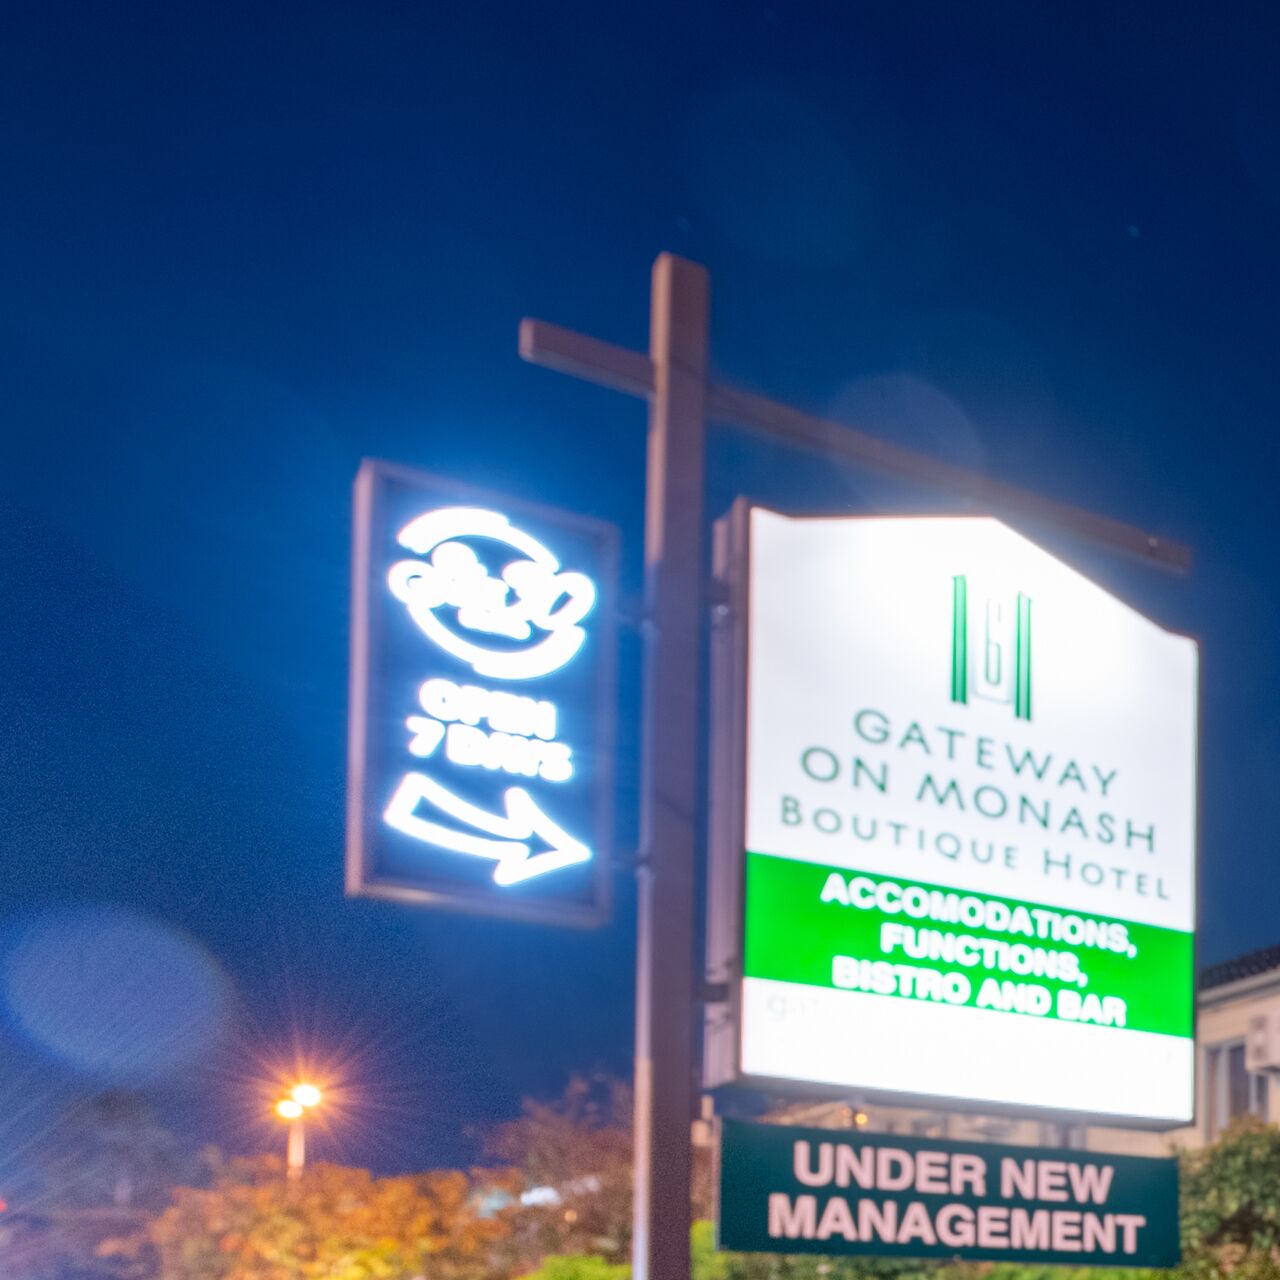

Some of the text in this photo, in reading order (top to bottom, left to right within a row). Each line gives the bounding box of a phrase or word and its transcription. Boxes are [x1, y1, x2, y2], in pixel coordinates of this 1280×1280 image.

[853, 708, 1119, 799] GATEWAY
[799, 745, 1158, 854] ON MONASH
[779, 794, 1172, 902] BOUTIQUE HOTEL
[819, 873, 1138, 959] ACCOMODATIONS,
[880, 921, 1088, 988] FUNCTIONS,
[831, 955, 1127, 1027] BISTRO AND BAR
[792, 1140, 1115, 1205] UNDER NEW
[767, 1192, 1147, 1255] MANAGEMENT
